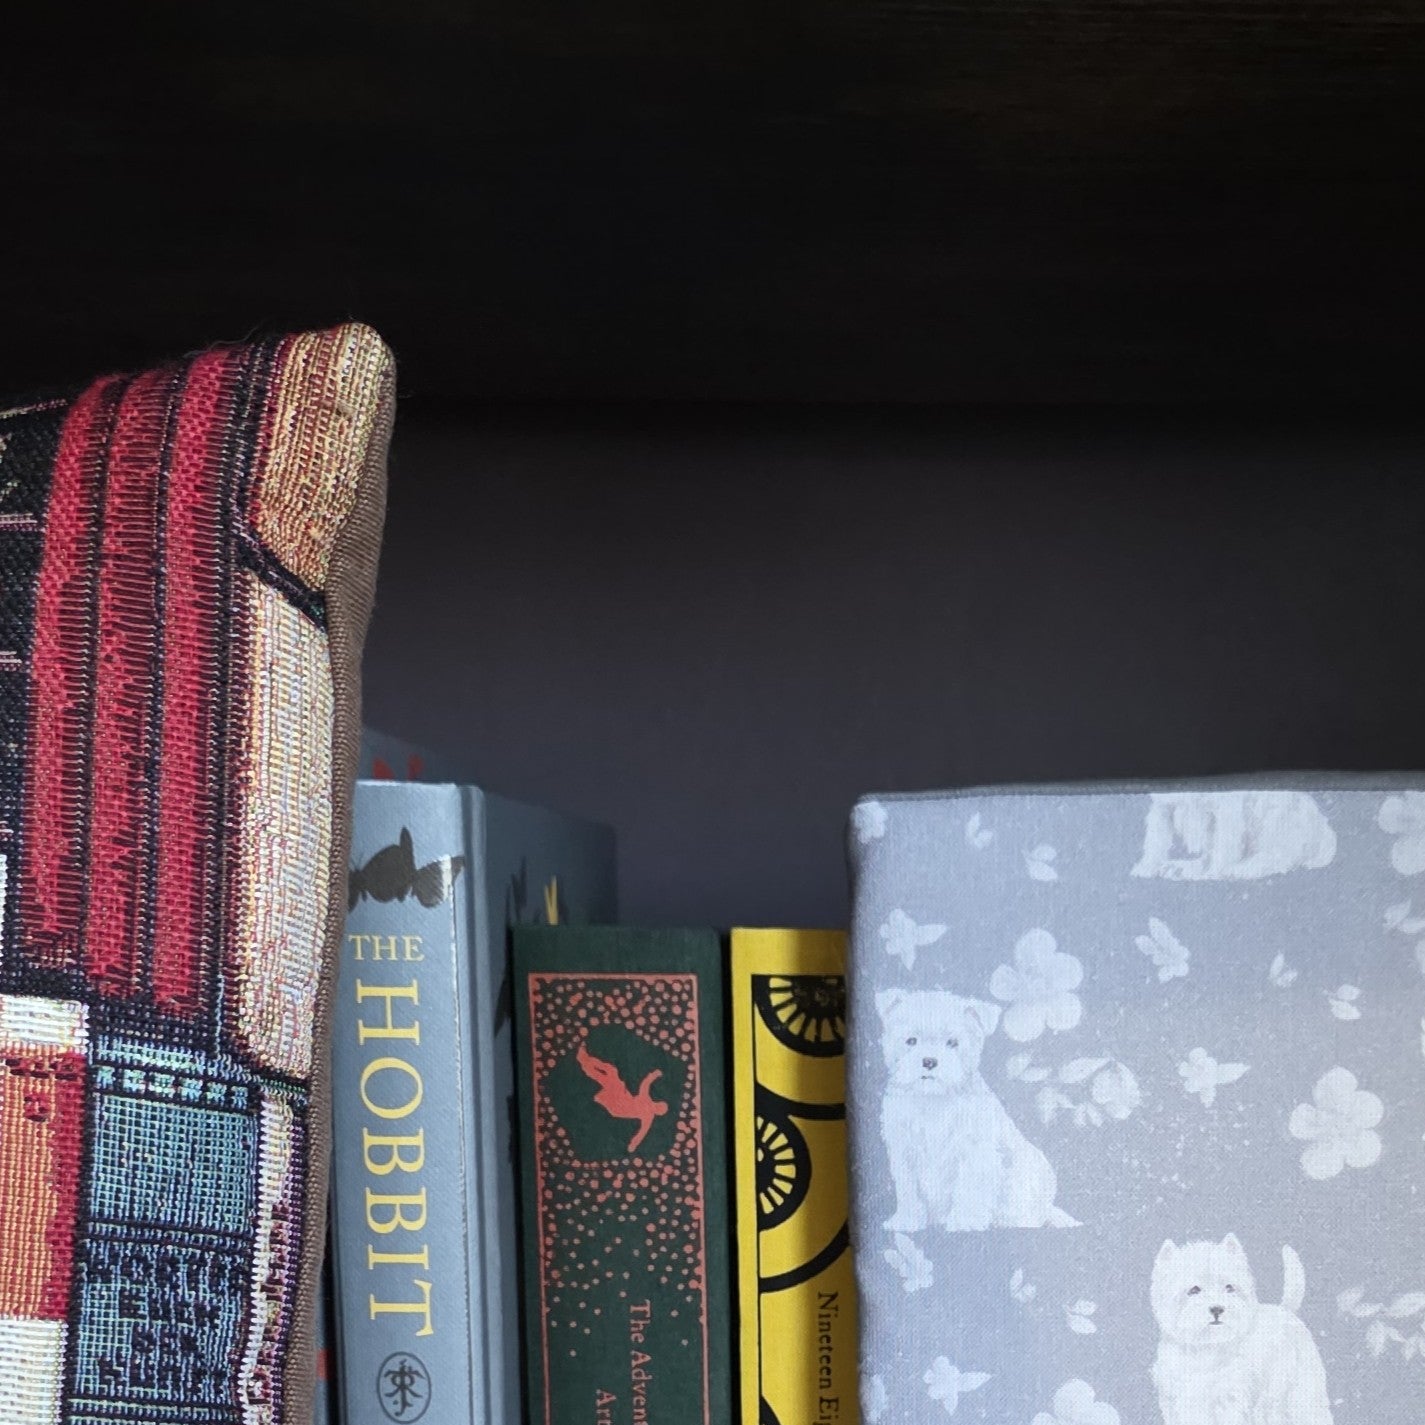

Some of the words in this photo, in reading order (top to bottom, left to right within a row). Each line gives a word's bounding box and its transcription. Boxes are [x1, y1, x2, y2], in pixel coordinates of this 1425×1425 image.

[349, 935, 425, 961] THE
[356, 978, 434, 1337] HOBBIT
[630, 1299, 651, 1344] The
[816, 1291, 839, 1391] Nineteen
